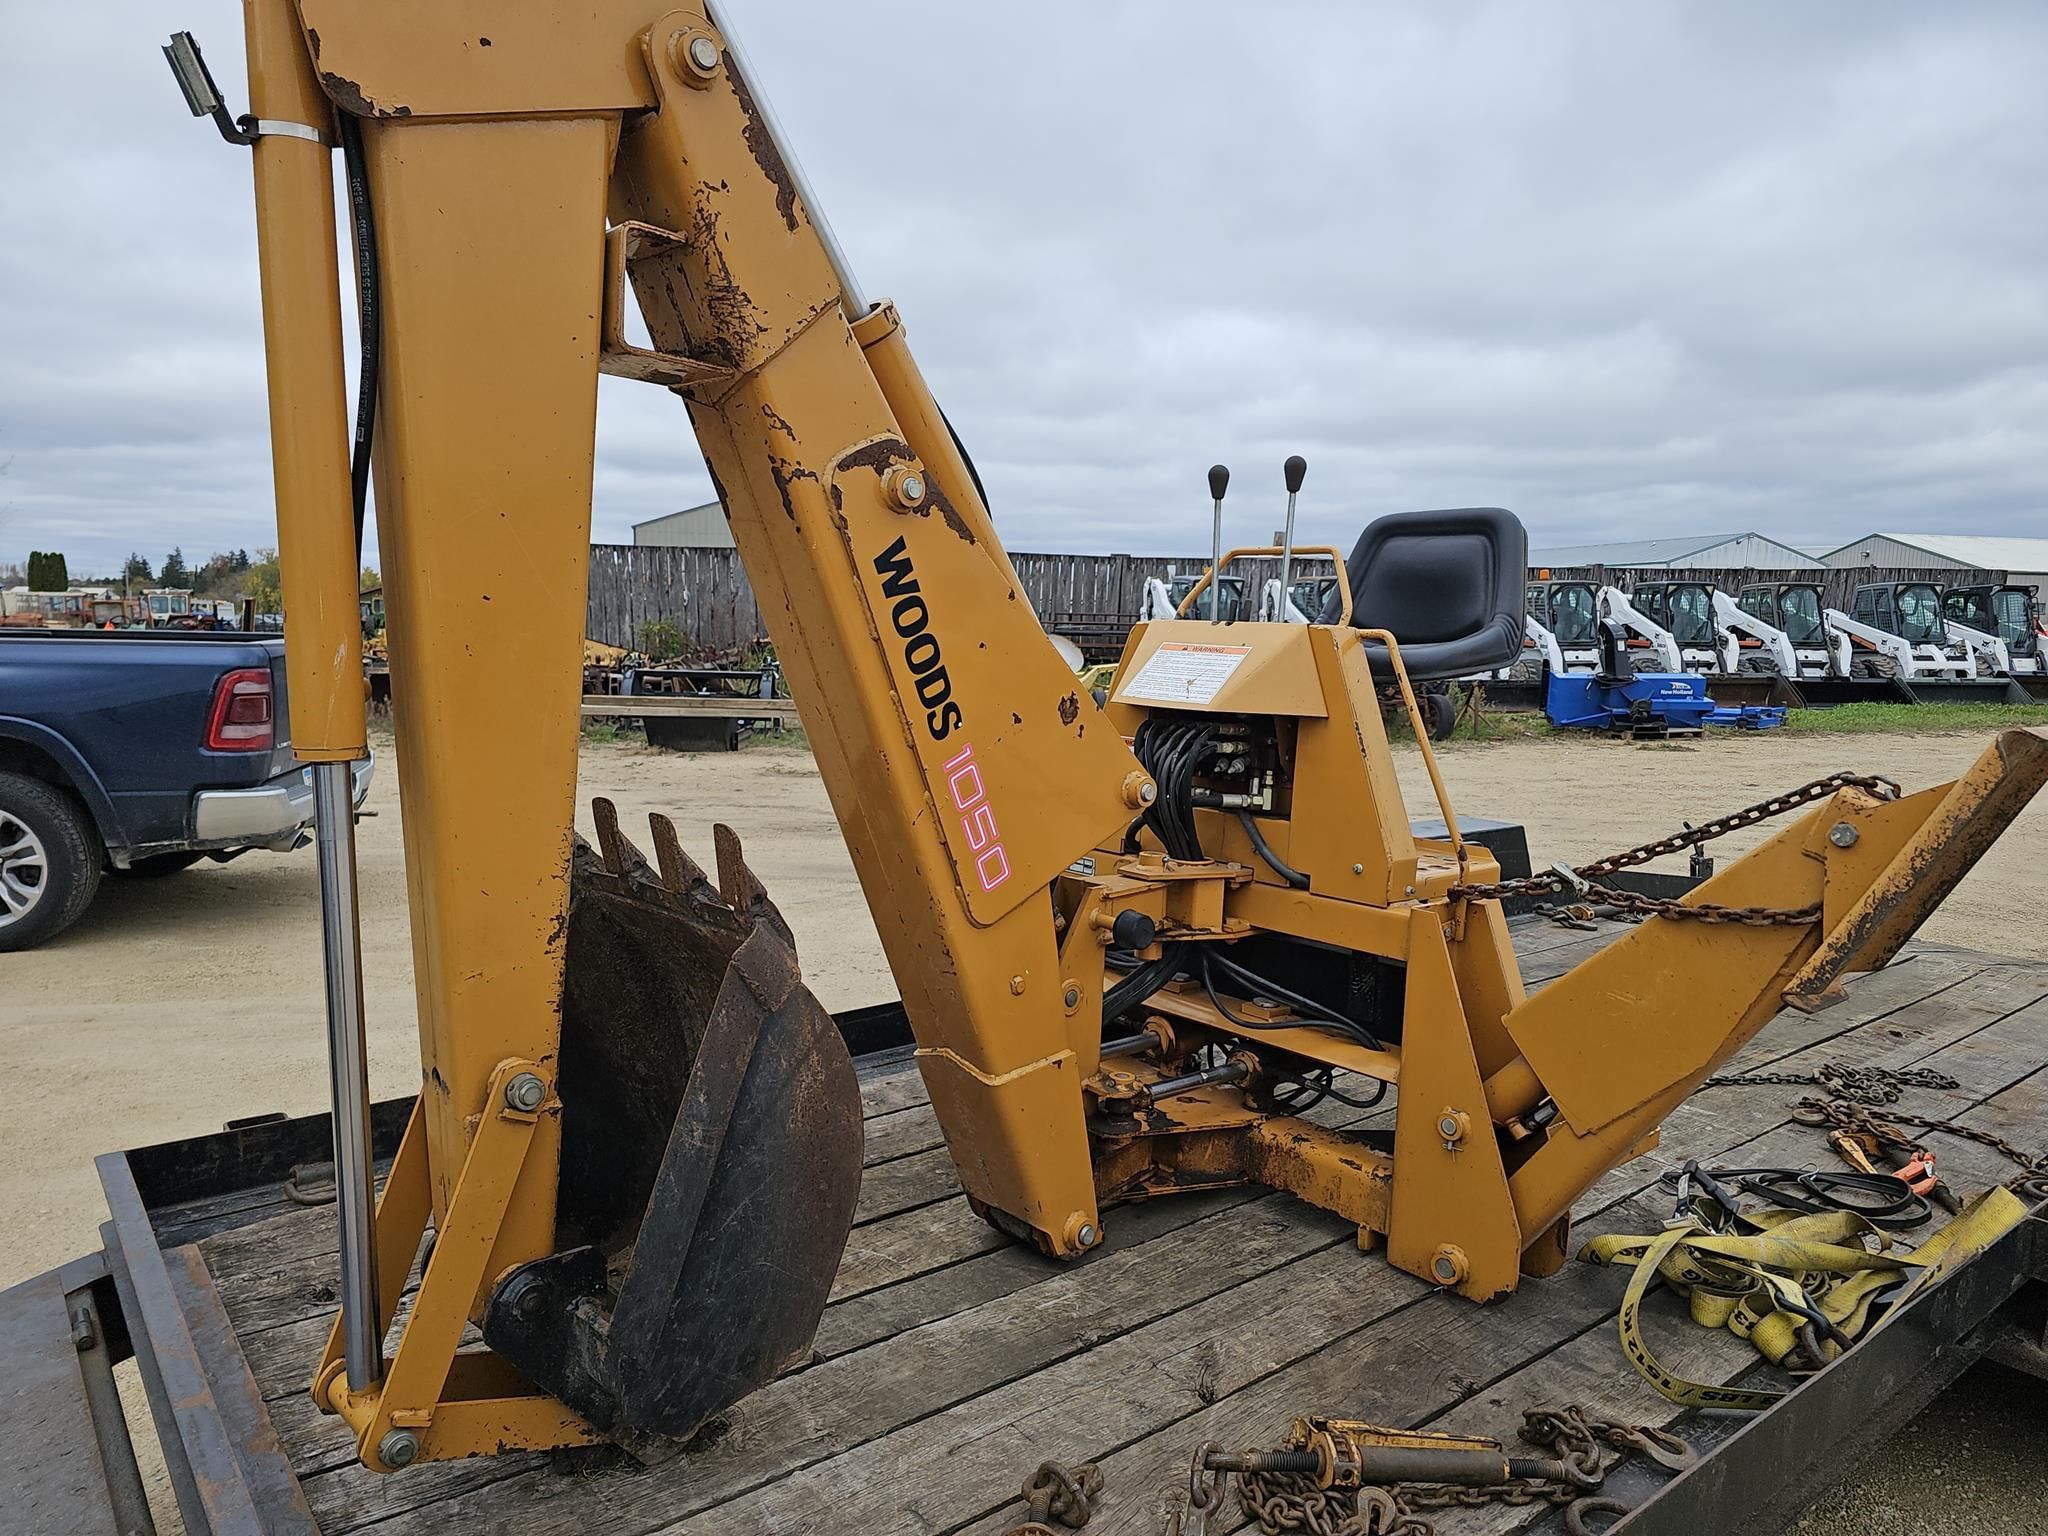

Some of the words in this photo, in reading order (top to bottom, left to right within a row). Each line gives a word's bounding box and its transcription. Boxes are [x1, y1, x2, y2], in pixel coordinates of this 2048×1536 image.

[1192, 646, 1225, 654] WARNING
[873, 535, 963, 742] WOODS
[943, 742, 1012, 893] 1050
[1623, 1302, 1635, 1335] KG
[1628, 1337, 1673, 1390] 1512
[1700, 1390, 1753, 1403] LBS
